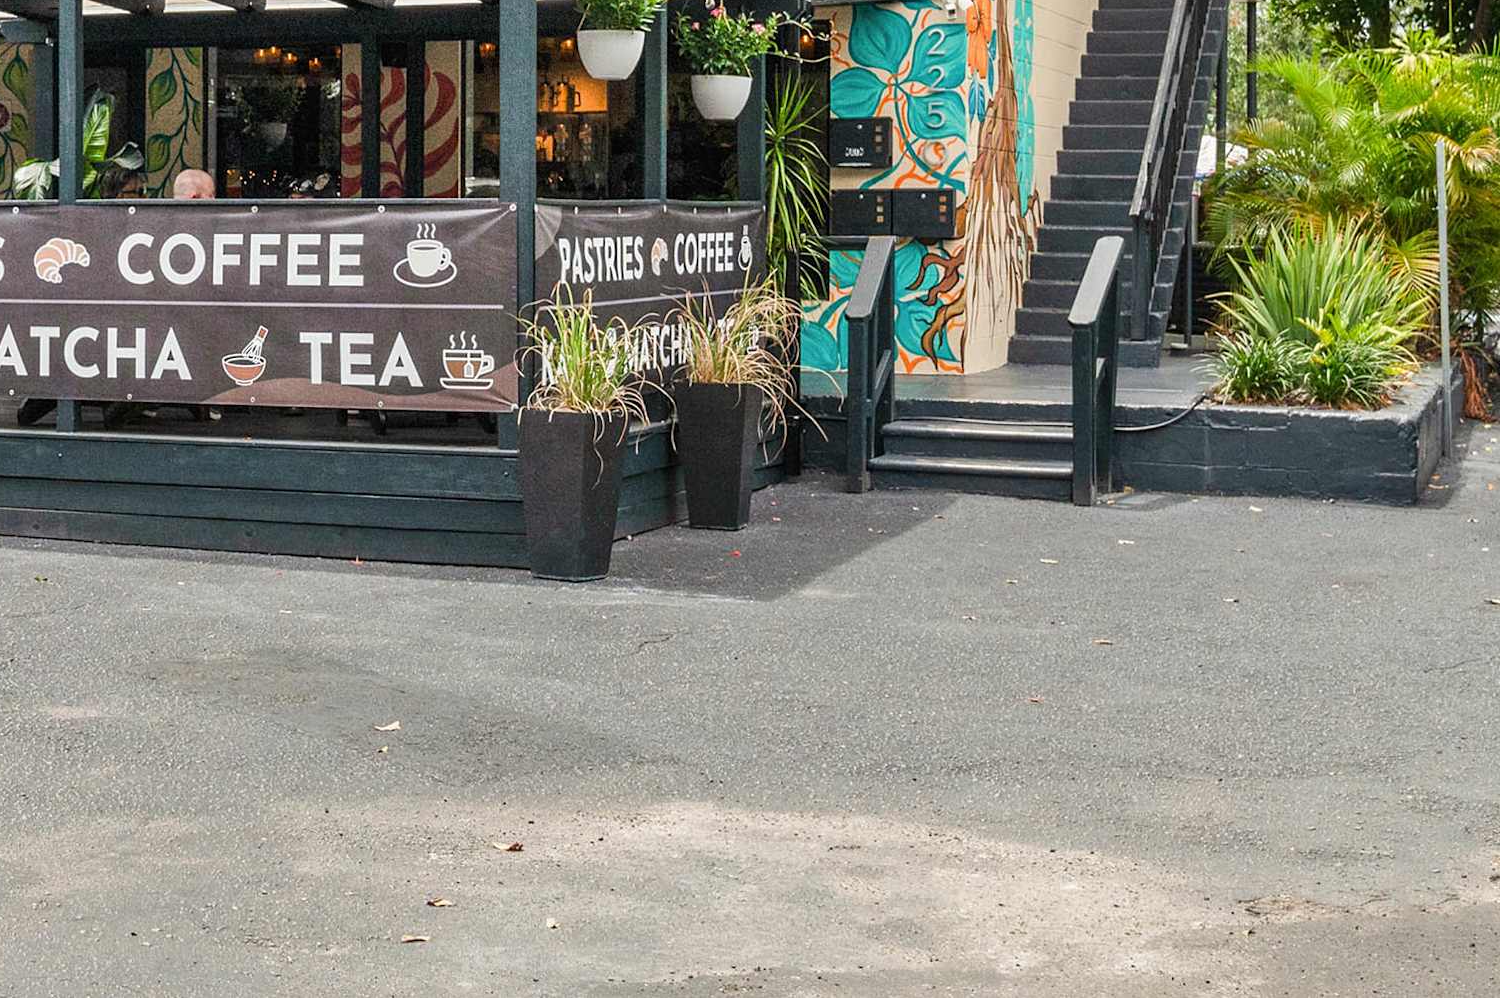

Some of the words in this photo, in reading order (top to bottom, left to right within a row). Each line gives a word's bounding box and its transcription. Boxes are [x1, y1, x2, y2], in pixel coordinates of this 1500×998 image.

[117, 232, 365, 287] COFFEE
[558, 235, 645, 284] PASTRIES
[673, 232, 735, 275] COFFEE
[299, 332, 424, 388] TEA
[623, 323, 694, 374] MATCHA
